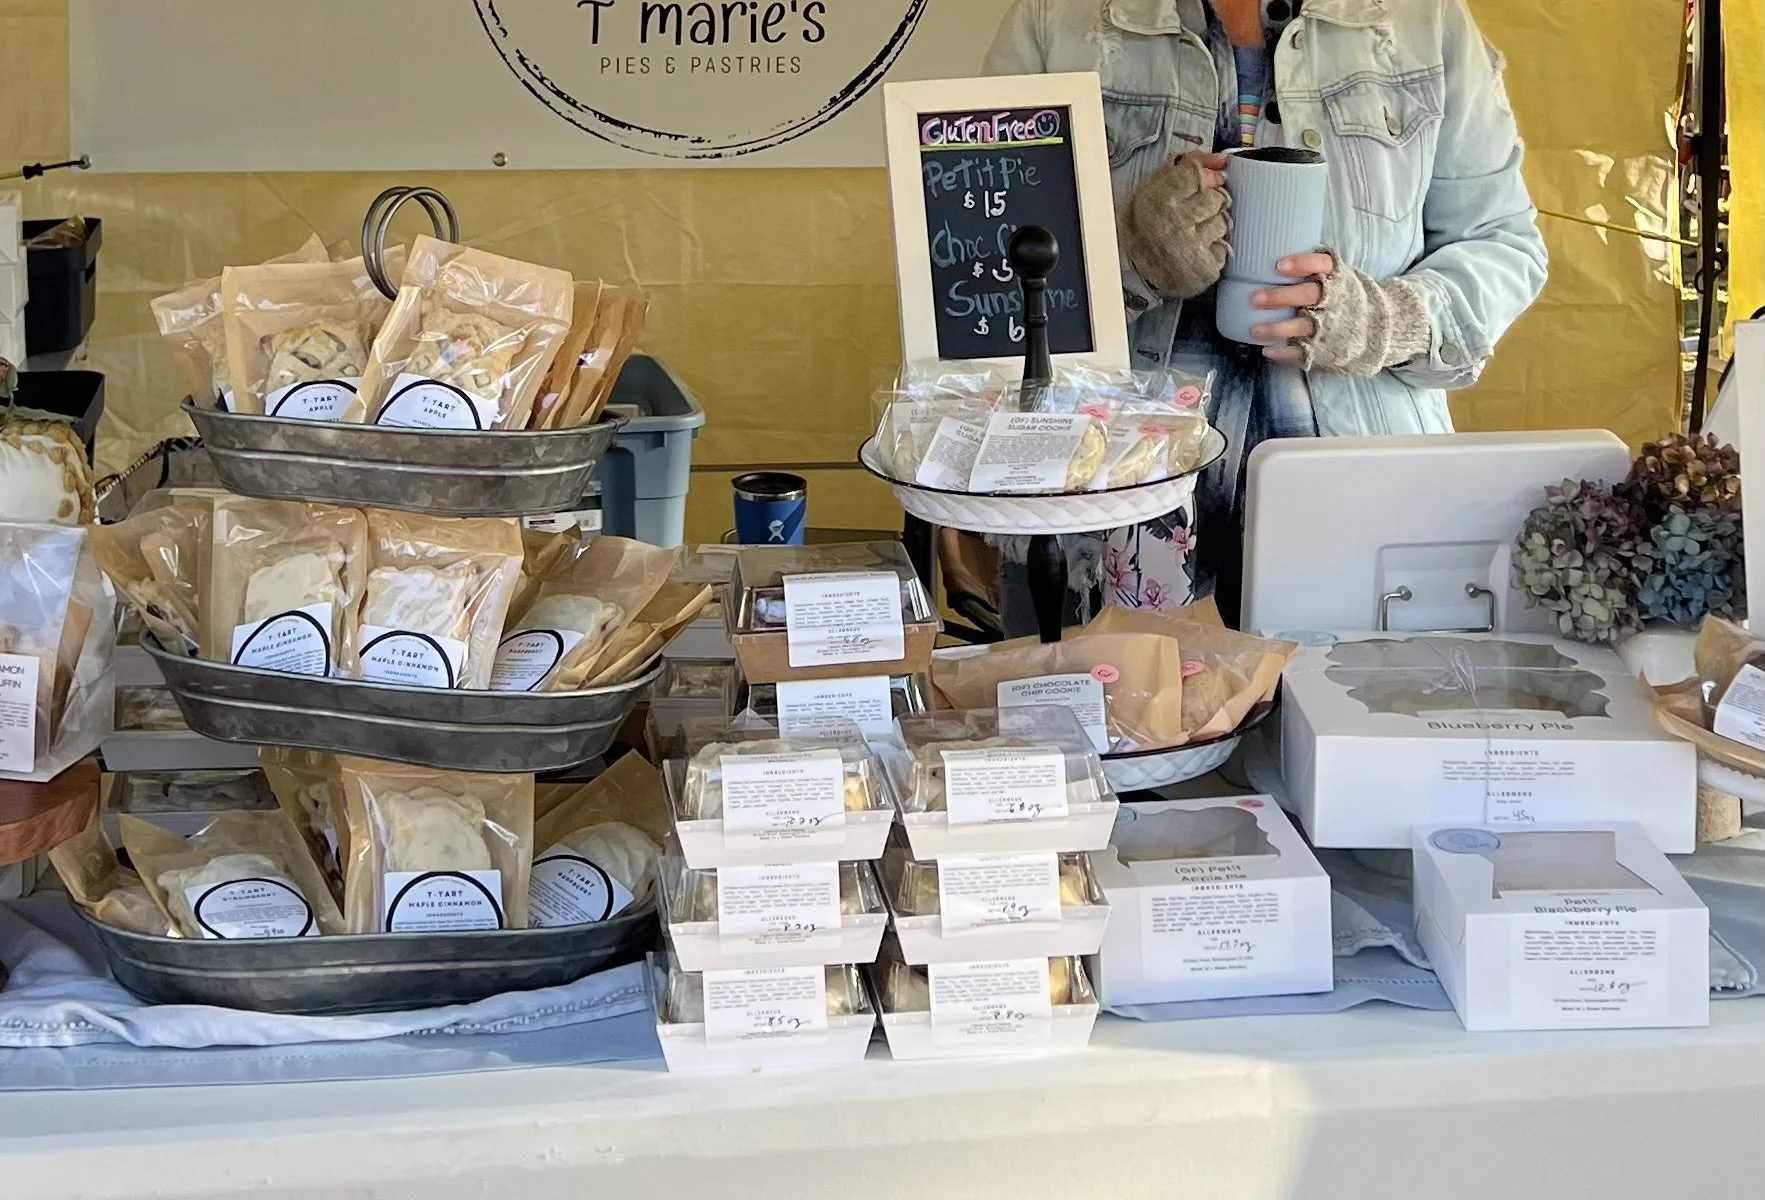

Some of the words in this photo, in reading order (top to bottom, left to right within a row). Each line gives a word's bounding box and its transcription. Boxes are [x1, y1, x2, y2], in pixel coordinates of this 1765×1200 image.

[577, 0, 615, 44] T
[640, 0, 826, 45] marie's
[600, 56, 651, 74] PIES
[665, 56, 676, 74] &
[690, 55, 801, 74] PASTRIES
[998, 157, 1041, 189] Pie
[945, 276, 1079, 318] Sunsne
[423, 407, 447, 418] APPLE
[1030, 417, 1074, 425] SUNSHINE
[1033, 679, 1090, 689] CHOCOLATE
[1427, 721, 1534, 731] Blueberry
[1541, 722, 1574, 730] Pie
[438, 900, 482, 908] CINNAMON
[1533, 905, 1611, 916] Blackberry
[1615, 905, 1637, 913] Pie
